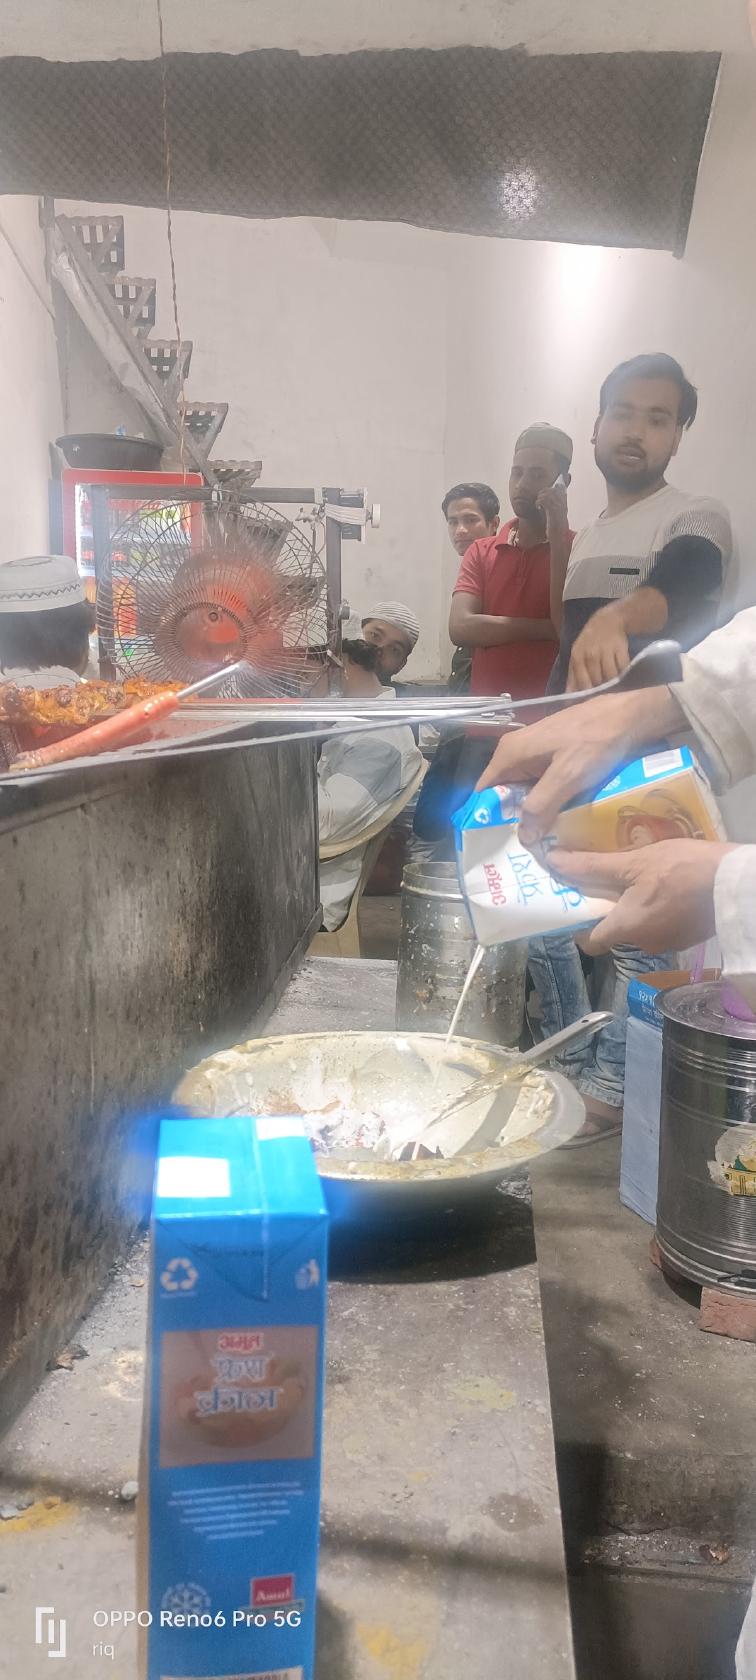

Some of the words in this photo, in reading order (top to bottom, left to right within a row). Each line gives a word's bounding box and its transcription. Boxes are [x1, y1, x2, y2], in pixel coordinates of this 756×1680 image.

[484, 863, 506, 906] अमूल
[217, 1334, 263, 1353] अमूल
[256, 1587, 291, 1603] Amul
